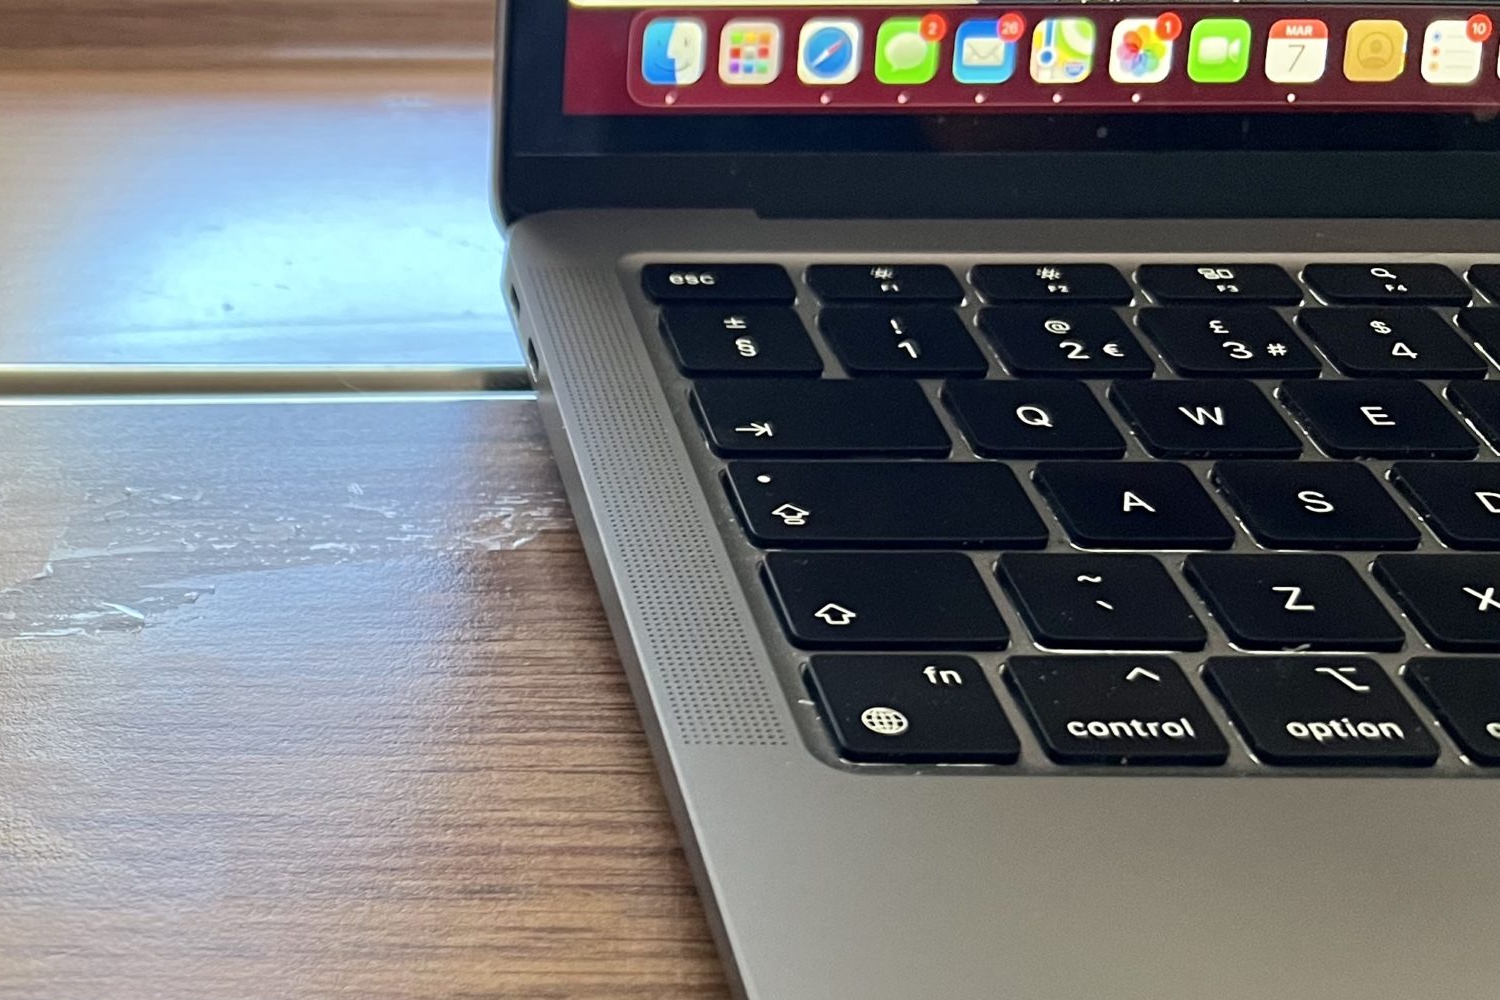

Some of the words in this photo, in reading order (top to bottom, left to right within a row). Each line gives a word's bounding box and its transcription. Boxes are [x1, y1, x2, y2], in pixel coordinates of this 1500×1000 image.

[1001, 20, 1018, 35] 26
[1285, 24, 1313, 37] MAR
[1471, 22, 1487, 35] 10
[1288, 44, 1306, 73] 7
[669, 273, 715, 285] esc
[1044, 319, 1071, 334] @
[1209, 319, 1230, 334] £
[1370, 319, 1392, 335] $
[897, 340, 918, 359] 1
[1059, 341, 1091, 359] 2
[1102, 343, 1125, 357] €
[1221, 341, 1254, 359] 3
[1391, 342, 1418, 360] 4
[1015, 405, 1054, 428] Q
[1178, 406, 1225, 426] W
[1360, 406, 1396, 426] E
[1122, 490, 1156, 513] A
[1298, 490, 1334, 513] S
[1271, 587, 1315, 611] Z
[1462, 586, 1500, 612] X
[923, 665, 963, 685] fn
[1067, 717, 1196, 738] control
[1286, 717, 1404, 742] option
